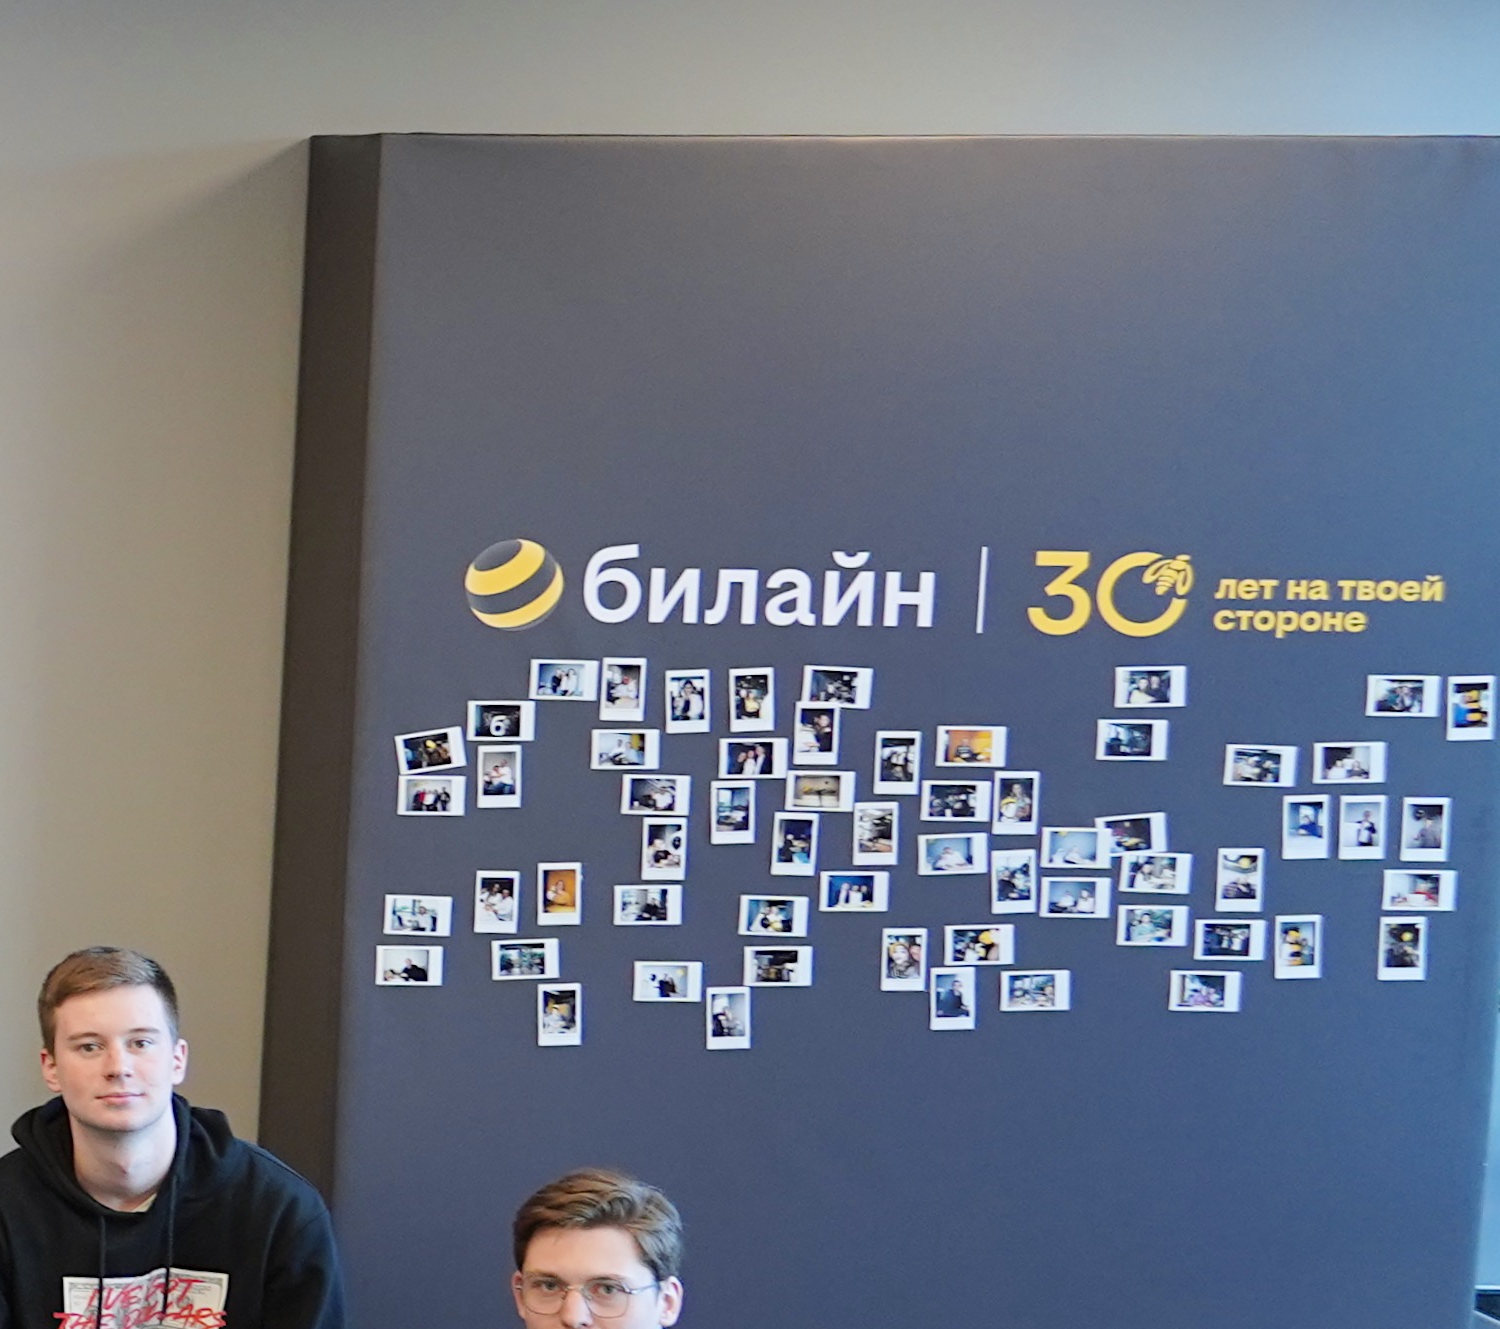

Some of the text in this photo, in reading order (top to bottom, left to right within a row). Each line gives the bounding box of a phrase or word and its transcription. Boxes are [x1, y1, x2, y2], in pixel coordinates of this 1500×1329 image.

[582, 543, 936, 629] билайн
[1214, 573, 1444, 604] лет на твоей
[1214, 607, 1368, 637] стороне
